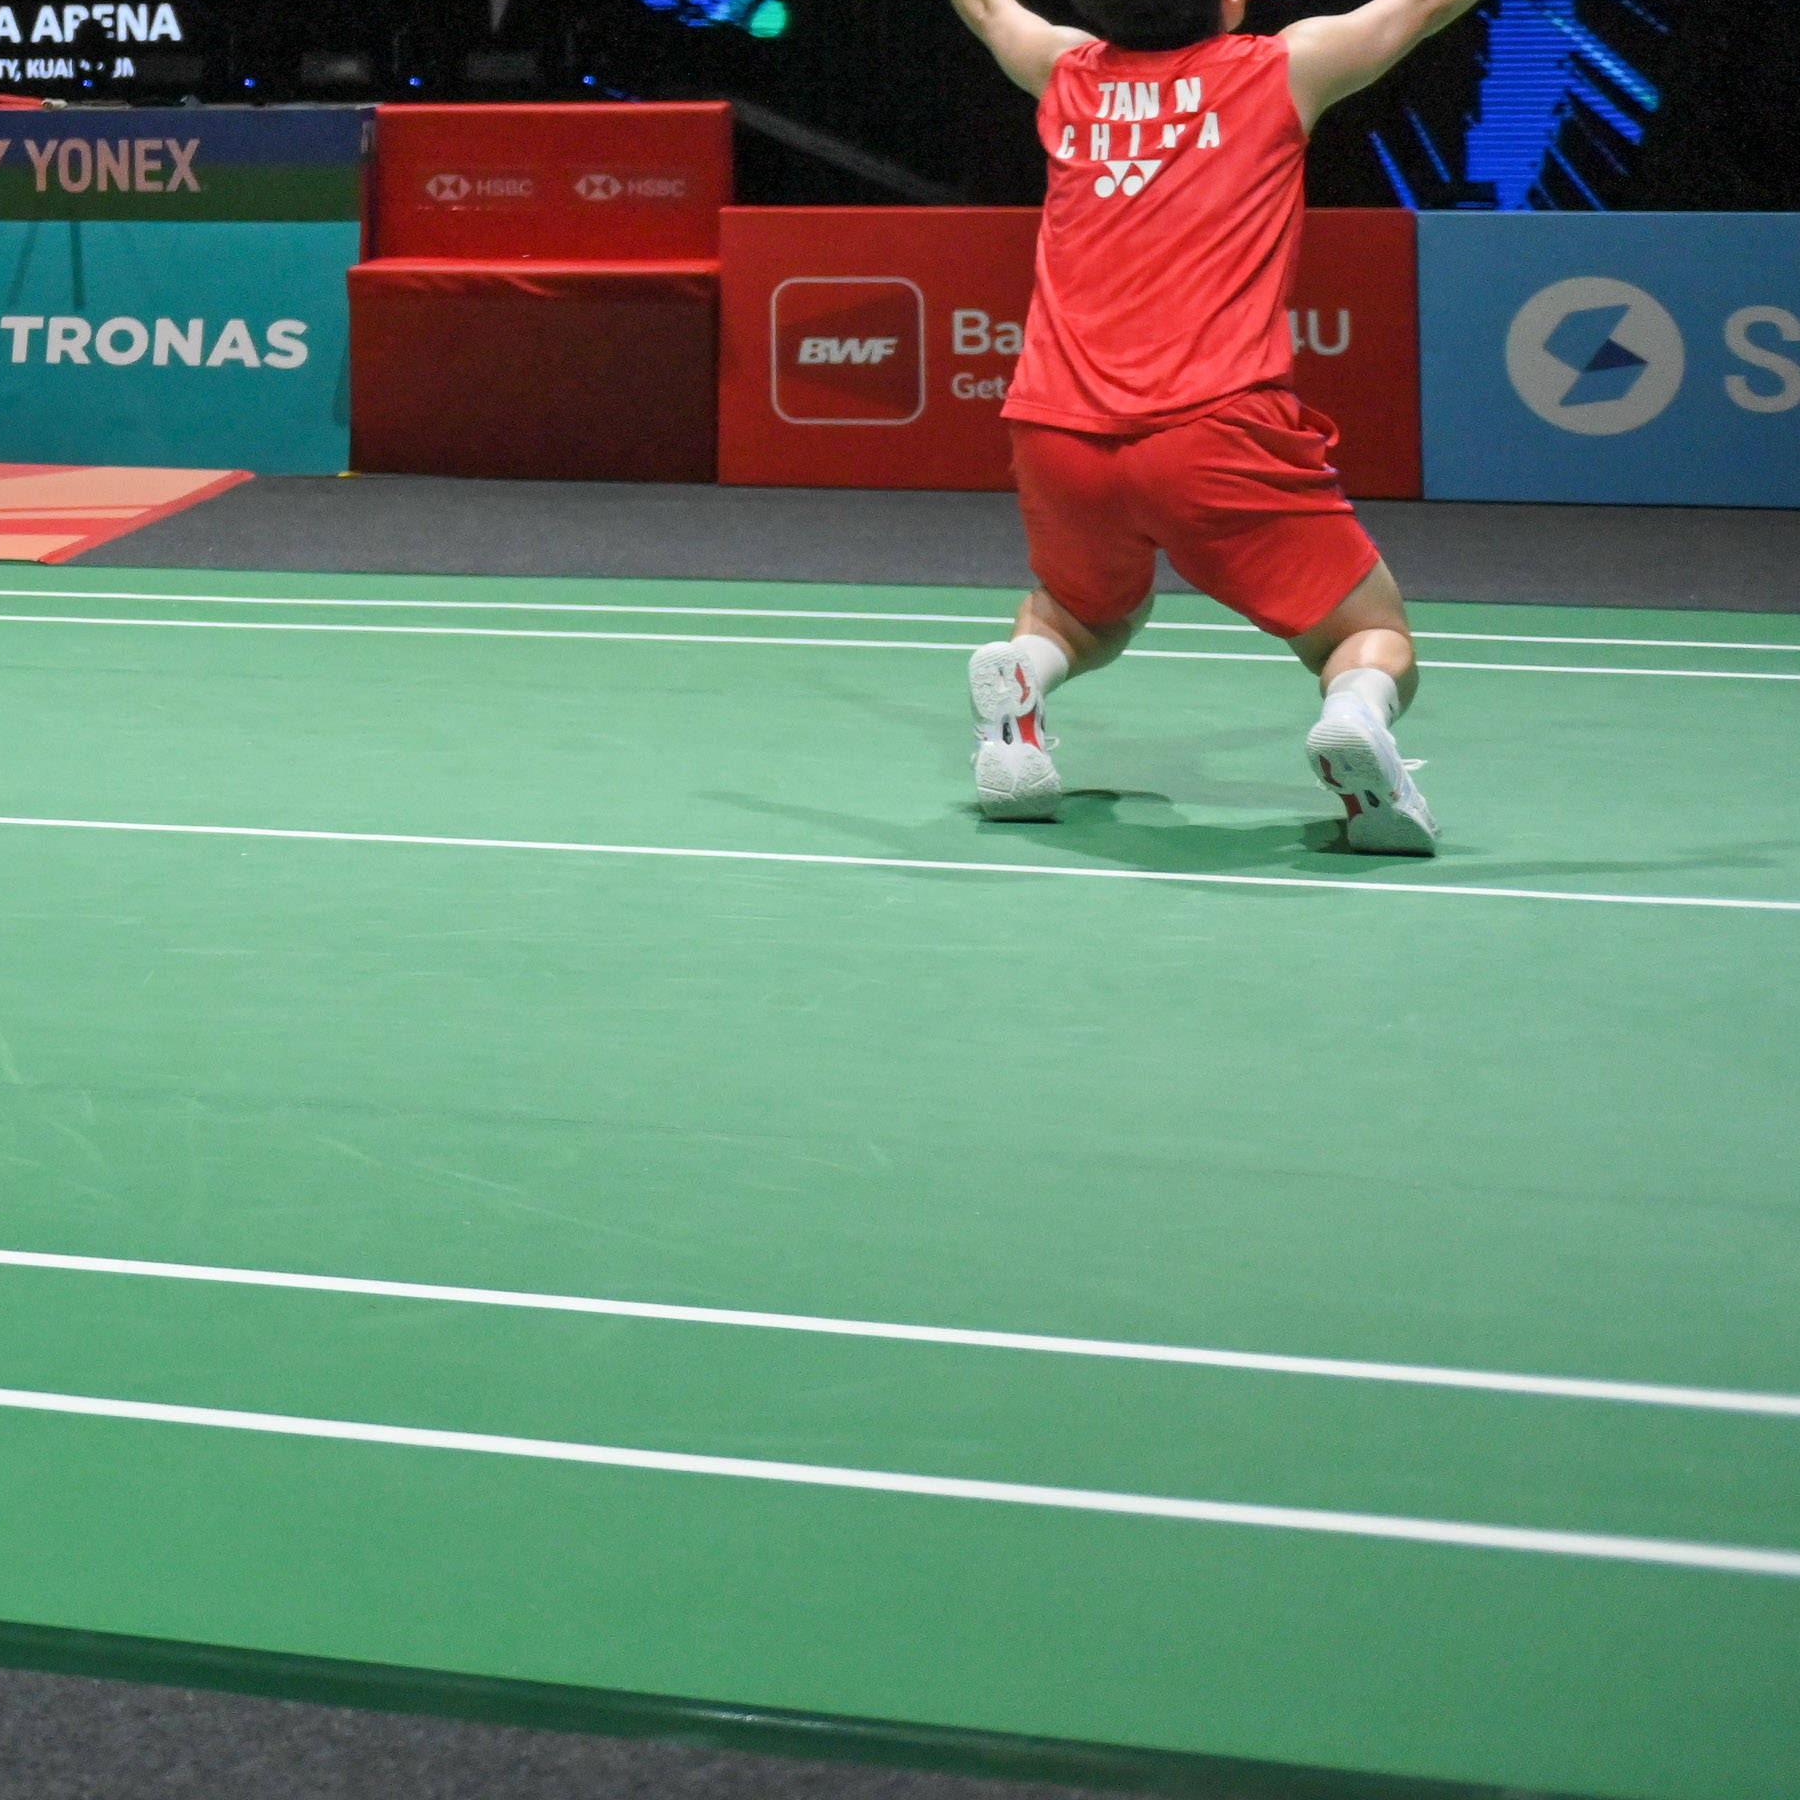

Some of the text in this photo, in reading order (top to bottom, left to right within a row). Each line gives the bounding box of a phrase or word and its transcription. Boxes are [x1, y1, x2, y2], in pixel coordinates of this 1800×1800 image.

[1099, 76, 1201, 120] TAN N
[1057, 111, 1221, 160] CHINA
[26, 138, 200, 193] YONEX
[476, 179, 532, 197] HSBC
[797, 337, 898, 364] BWF
